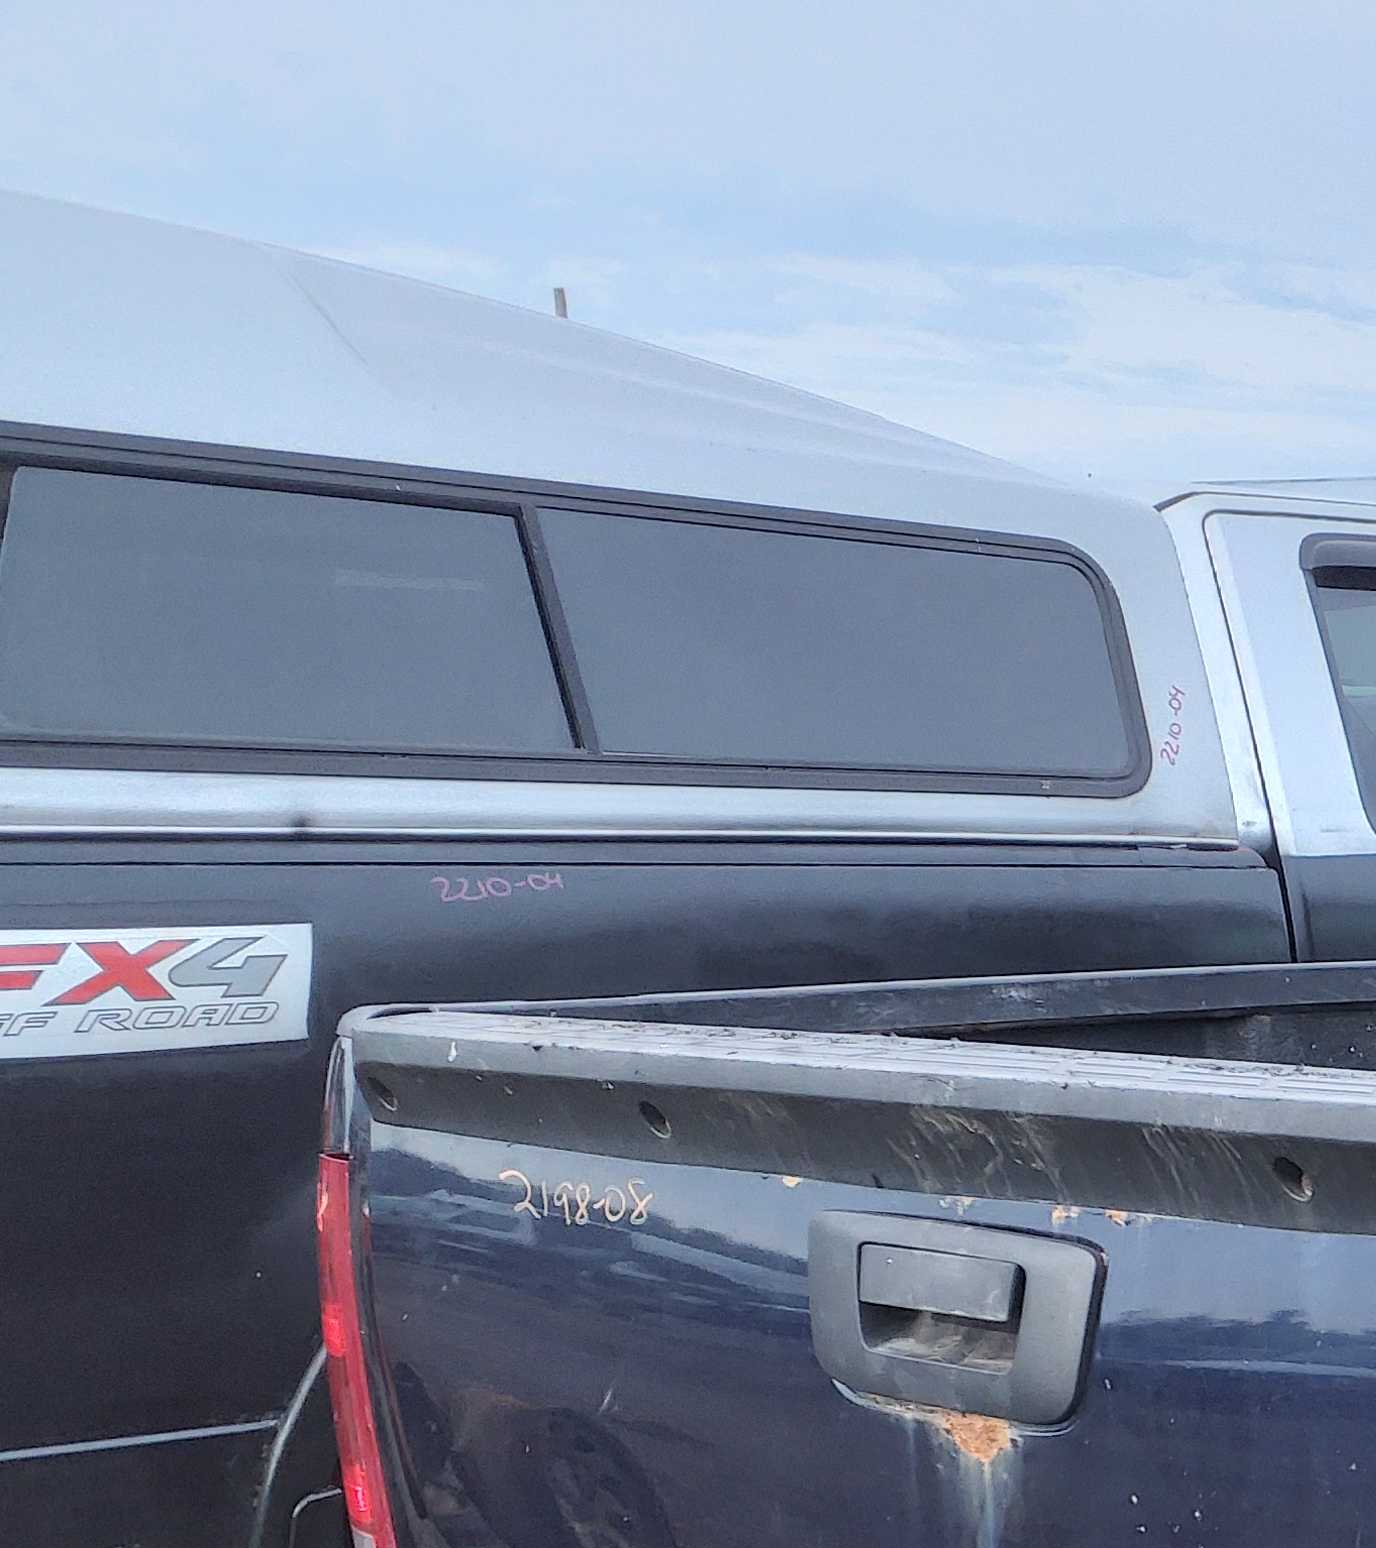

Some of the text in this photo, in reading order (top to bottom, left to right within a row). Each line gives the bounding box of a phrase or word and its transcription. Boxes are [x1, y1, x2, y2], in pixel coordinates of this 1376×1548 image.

[1160, 686, 1185, 766] 2210-04
[431, 873, 564, 902] 2210-04
[75, 1002, 279, 1033] ROAD
